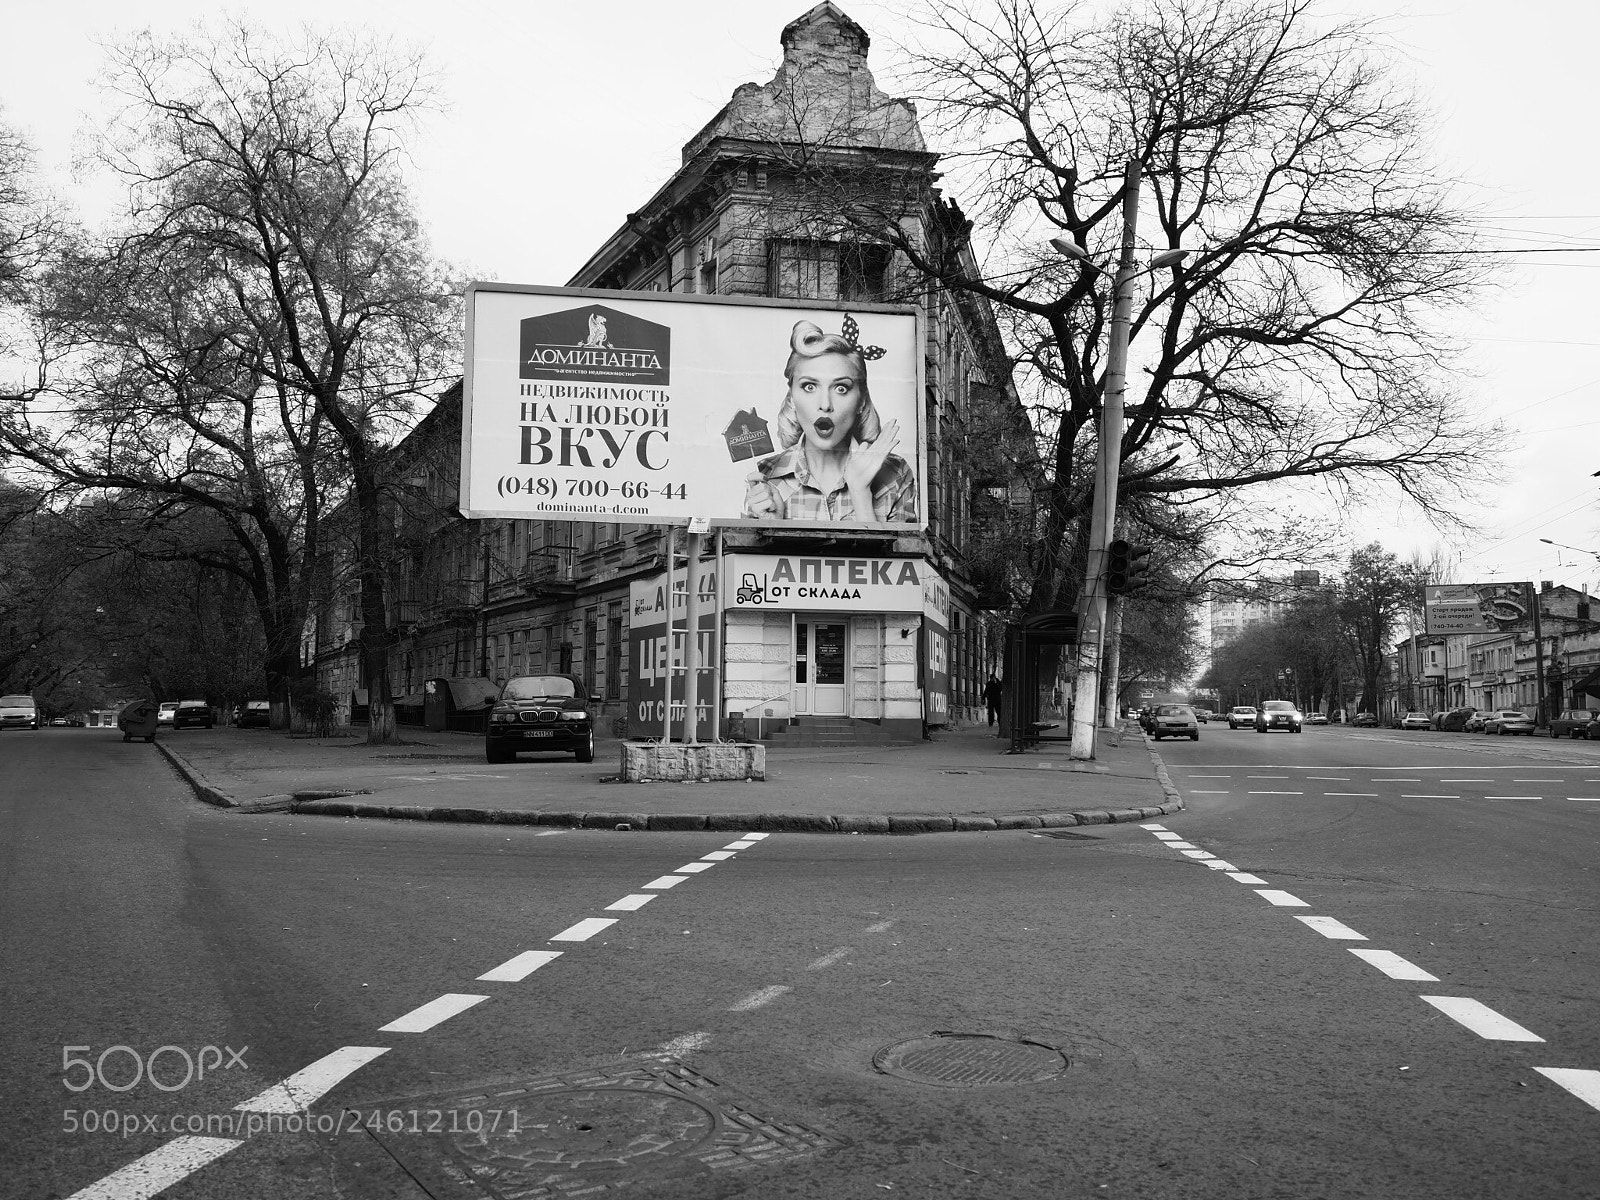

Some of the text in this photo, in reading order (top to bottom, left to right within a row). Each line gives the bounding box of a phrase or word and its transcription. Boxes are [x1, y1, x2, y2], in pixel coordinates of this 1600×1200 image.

[528, 348, 663, 370] ДОМИНАНТА
[520, 383, 670, 403] НЕДВИЖИМОСТЬ
[519, 402, 670, 427] НА ЛЮБОЙ
[517, 425, 670, 471] ВКУС
[497, 475, 689, 500] (048) 700-66-44
[536, 501, 650, 515] dominanta-d.com
[771, 557, 921, 586] АПТЕКА
[771, 586, 862, 600] ОТ СКЛАДА
[638, 700, 654, 722] ОТ
